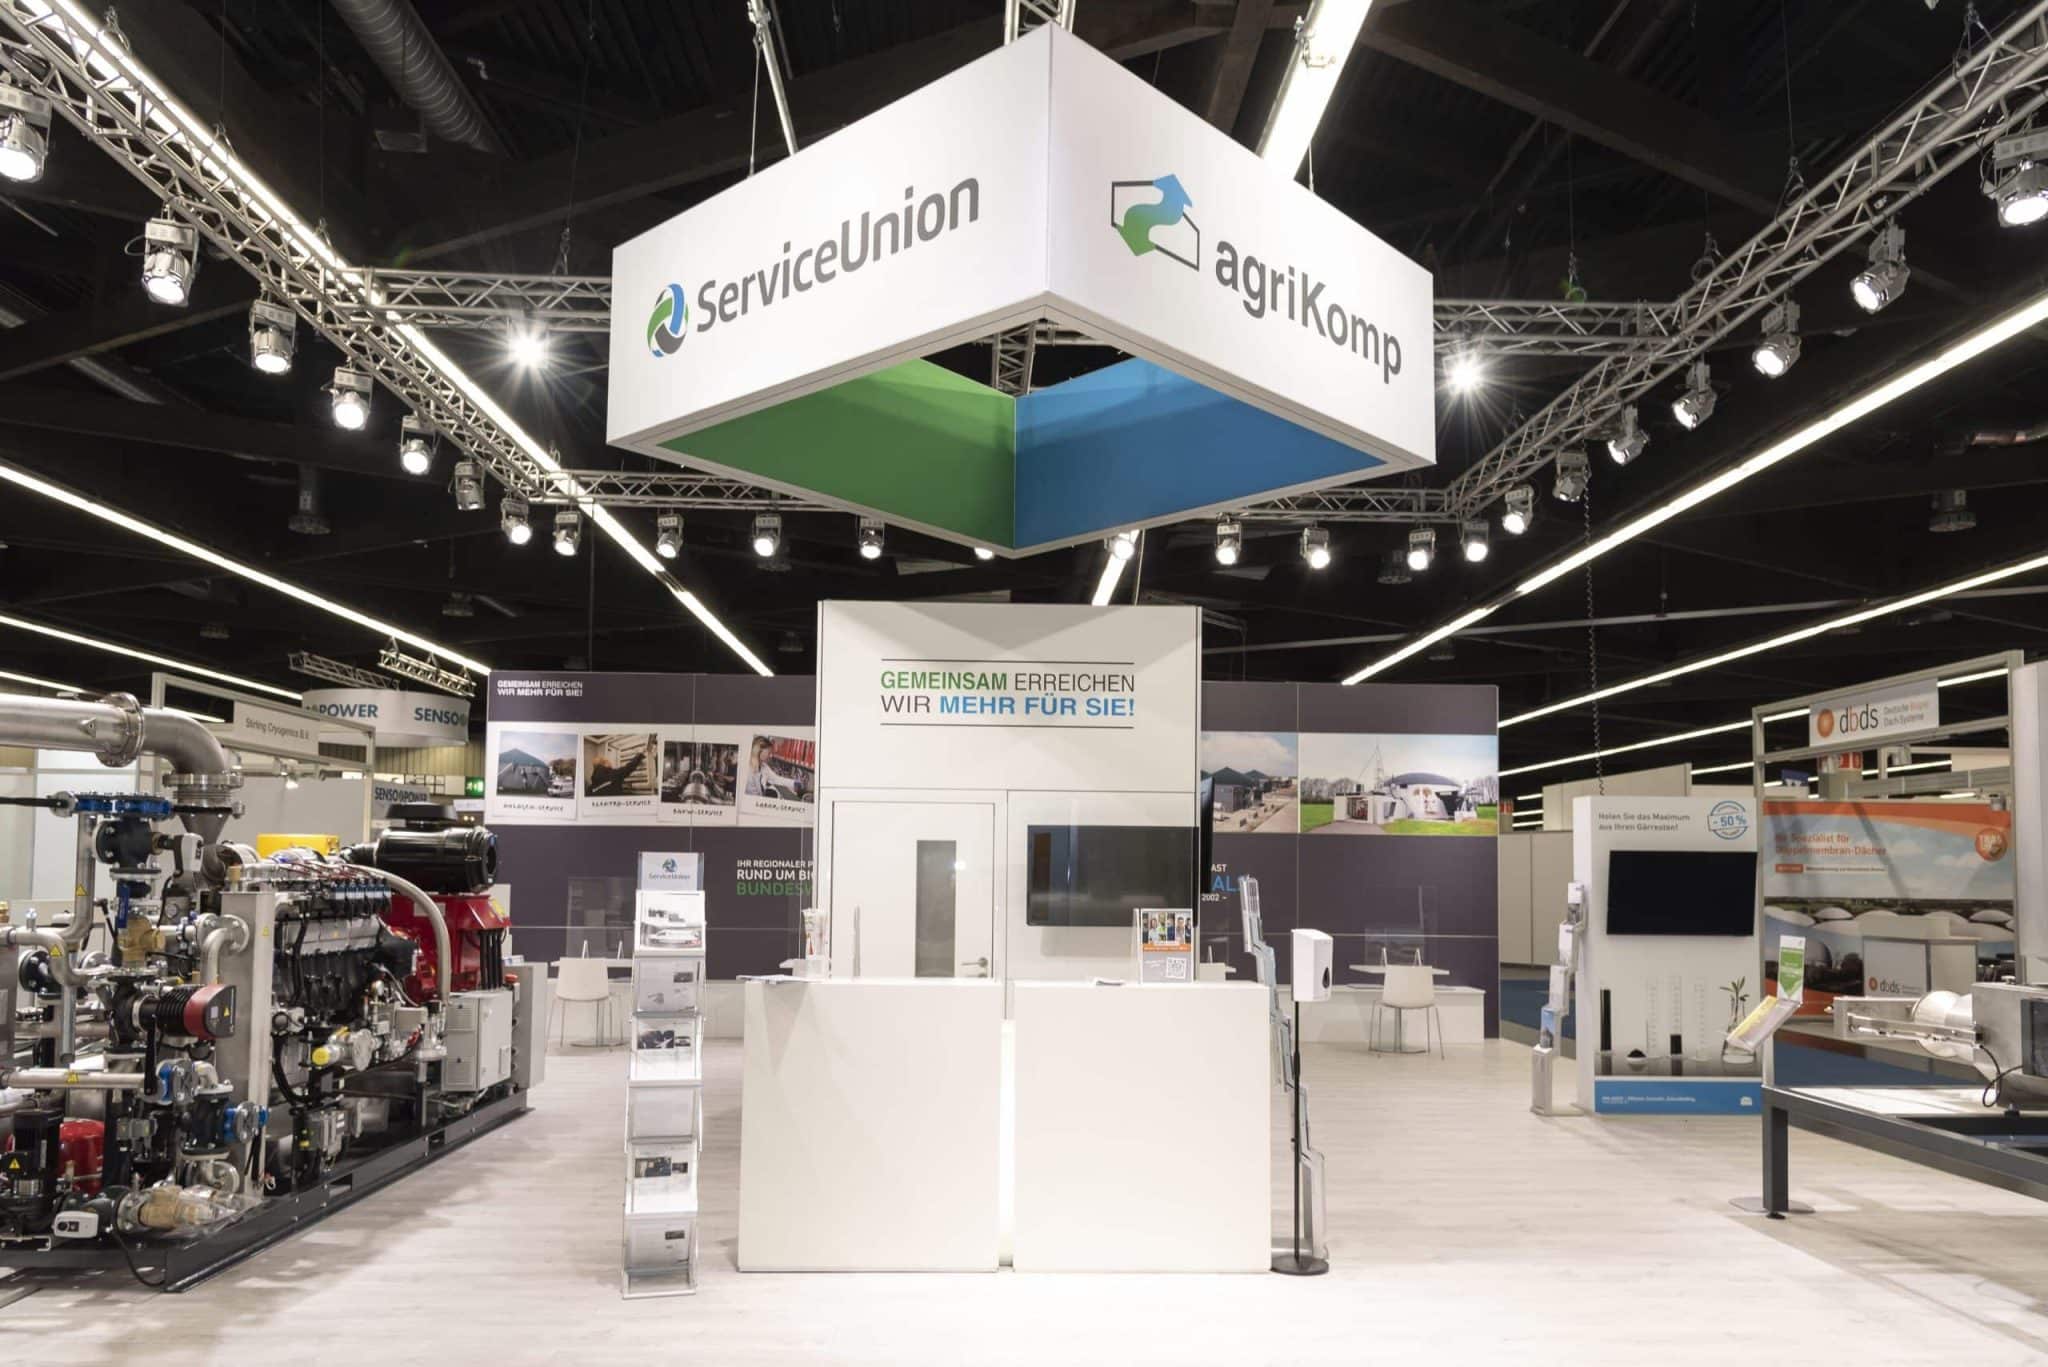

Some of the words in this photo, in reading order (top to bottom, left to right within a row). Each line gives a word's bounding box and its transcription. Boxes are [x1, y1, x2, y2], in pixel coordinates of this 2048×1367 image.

[697, 177, 979, 332] ServiceUnion
[1216, 237, 1402, 384] agriKomp
[497, 680, 540, 688] GEMEINSAM
[541, 680, 583, 689] ERREICHEN
[881, 671, 1008, 690] GEMEINSAM
[1014, 673, 1135, 692] ERREICHEN
[497, 688, 515, 696] WIR
[517, 688, 543, 696] MEHR
[545, 687, 563, 696] FÜR
[565, 688, 583, 697] SIE!
[319, 703, 378, 718] POWER
[881, 695, 931, 713] WIR
[939, 696, 1016, 715] MEHR
[1024, 692, 1077, 716] FÜR
[1085, 698, 1135, 716] SIE!
[414, 707, 459, 725] SENSO
[1840, 703, 1879, 734] dbds
[1623, 812, 1635, 820] Sie
[1637, 813, 1650, 821] das
[736, 859, 751, 868] IHR
[753, 859, 806, 868] REGIONALER
[736, 869, 773, 880] RUND
[775, 869, 796, 880] UM
